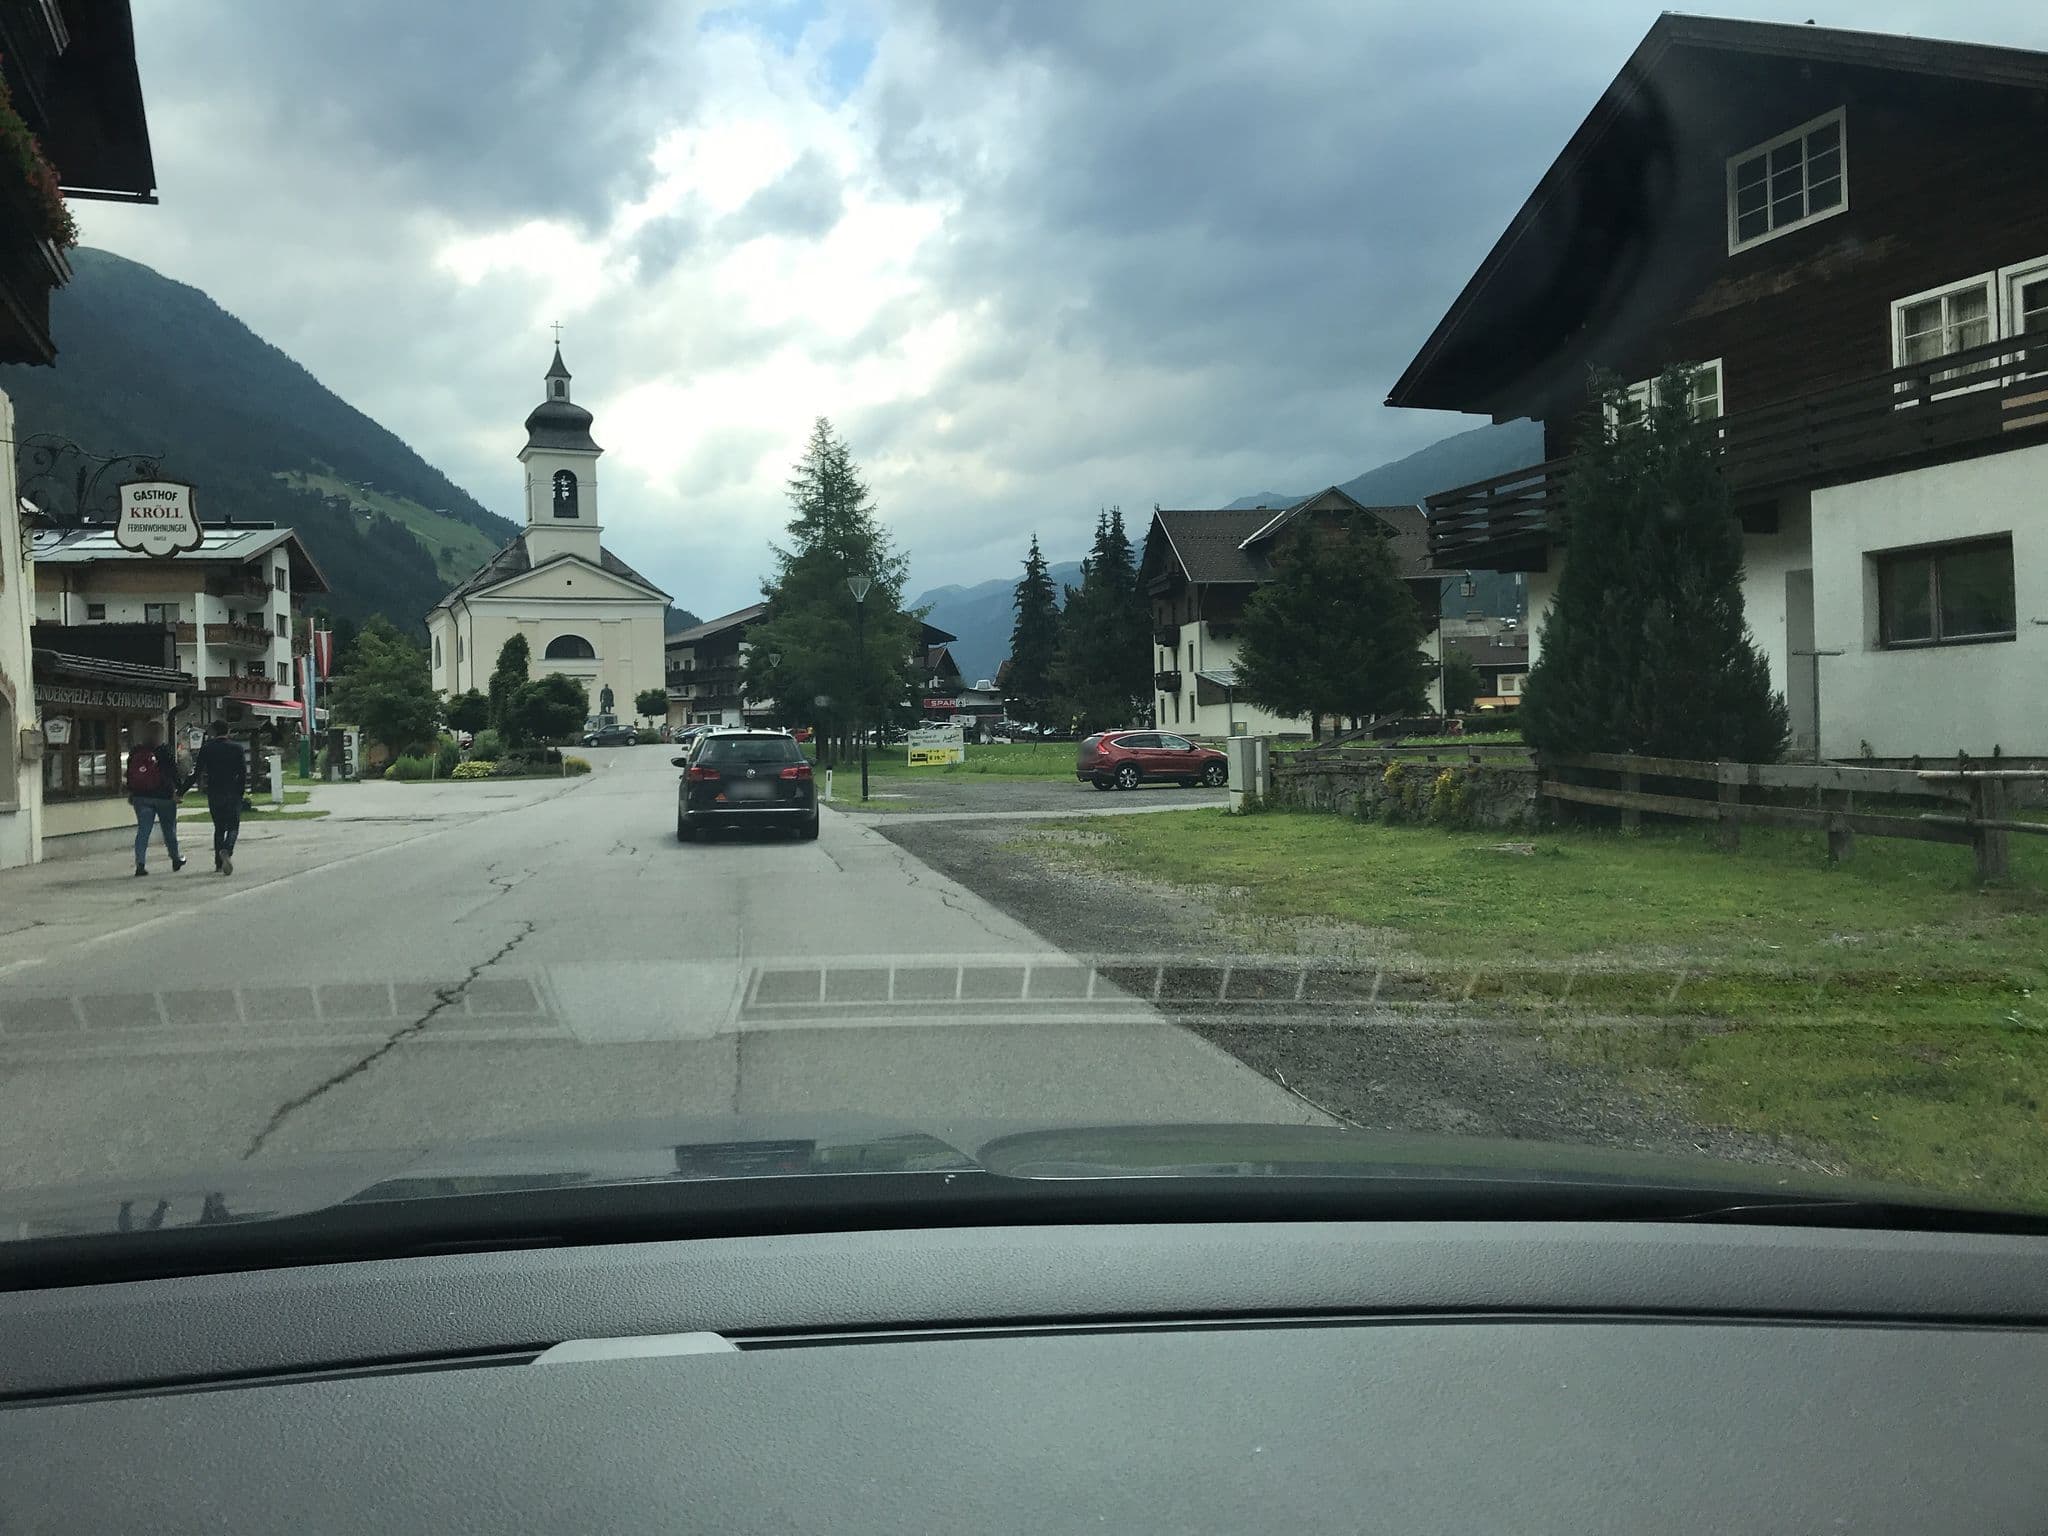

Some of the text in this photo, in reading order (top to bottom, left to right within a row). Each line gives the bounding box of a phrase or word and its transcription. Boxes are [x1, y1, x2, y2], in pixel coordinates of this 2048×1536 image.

[133, 490, 178, 501] GASTHOF
[130, 505, 183, 518] KRÖLL
[127, 523, 187, 532] FERIENWOHNUNGEN
[106, 690, 163, 709] SCHWIMMBAD
